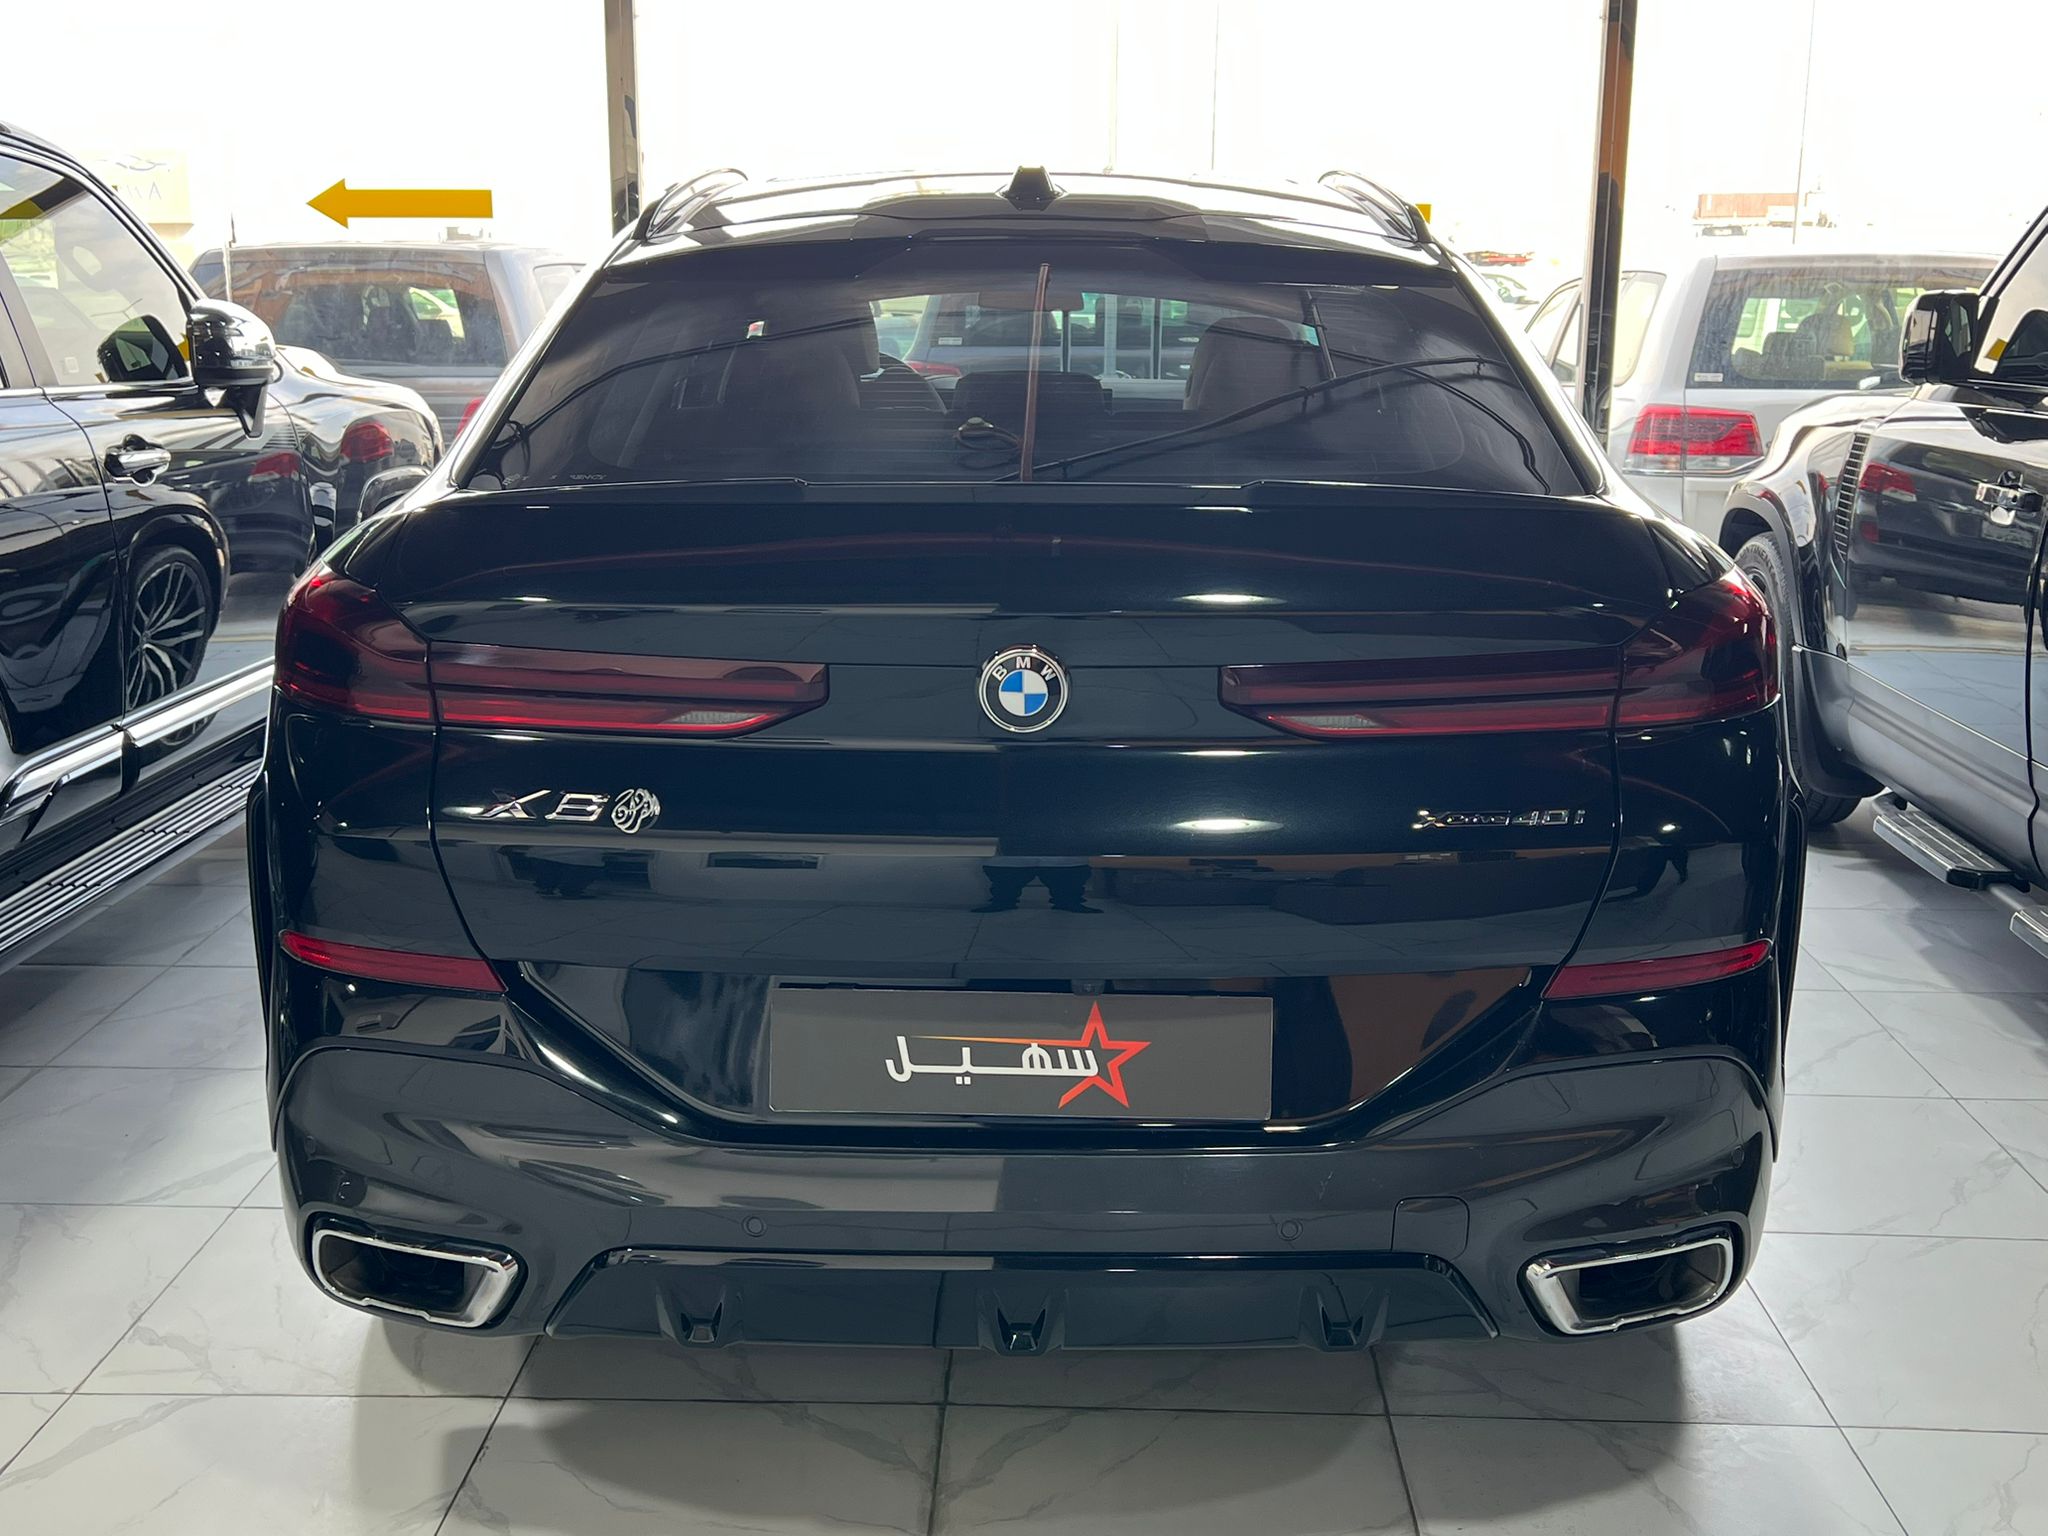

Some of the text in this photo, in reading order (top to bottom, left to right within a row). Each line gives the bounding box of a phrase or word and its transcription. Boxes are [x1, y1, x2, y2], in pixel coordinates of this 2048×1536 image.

[992, 656, 1056, 681] BMW
[469, 788, 610, 822] X6
[884, 1034, 1099, 1085] سهيل
